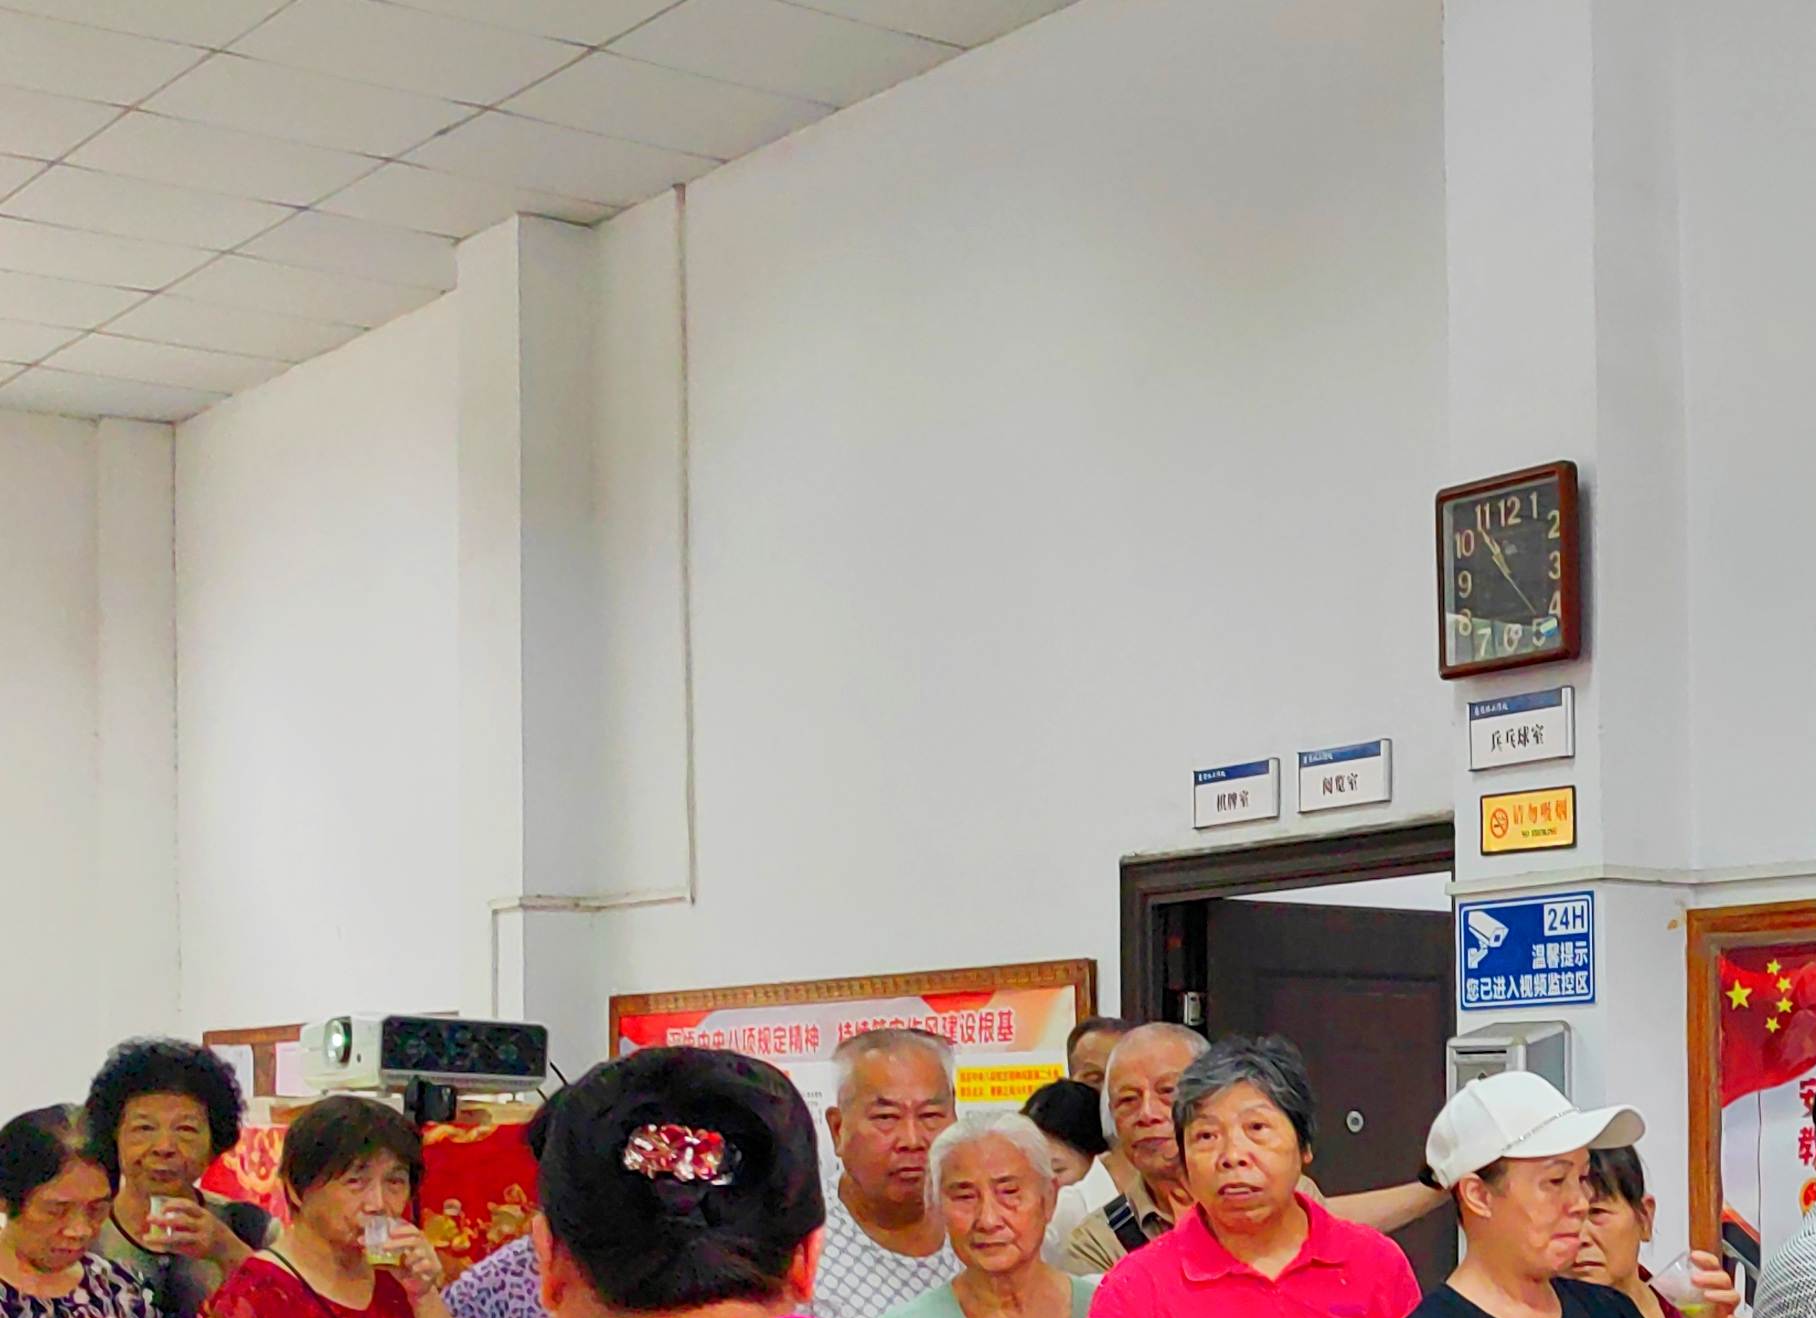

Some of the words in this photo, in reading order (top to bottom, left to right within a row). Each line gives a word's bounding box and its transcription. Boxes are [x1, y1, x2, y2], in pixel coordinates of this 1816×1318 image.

[1474, 502, 1491, 530] 11
[1498, 495, 1522, 527] 12
[1529, 491, 1539, 520] 1
[1547, 509, 1560, 540] 2
[1455, 529, 1475, 560] 10
[1548, 550, 1561, 580] 3
[1458, 570, 1473, 599] 9
[1549, 590, 1562, 617] 4
[1458, 608, 1472, 637] 8
[1531, 618, 1547, 647] 5
[1477, 627, 1492, 657] 7
[1547, 904, 1585, 932] 24H
[1531, 940, 1589, 970] 温馨提示
[1466, 970, 1589, 1002] 您已进入视频监控区
